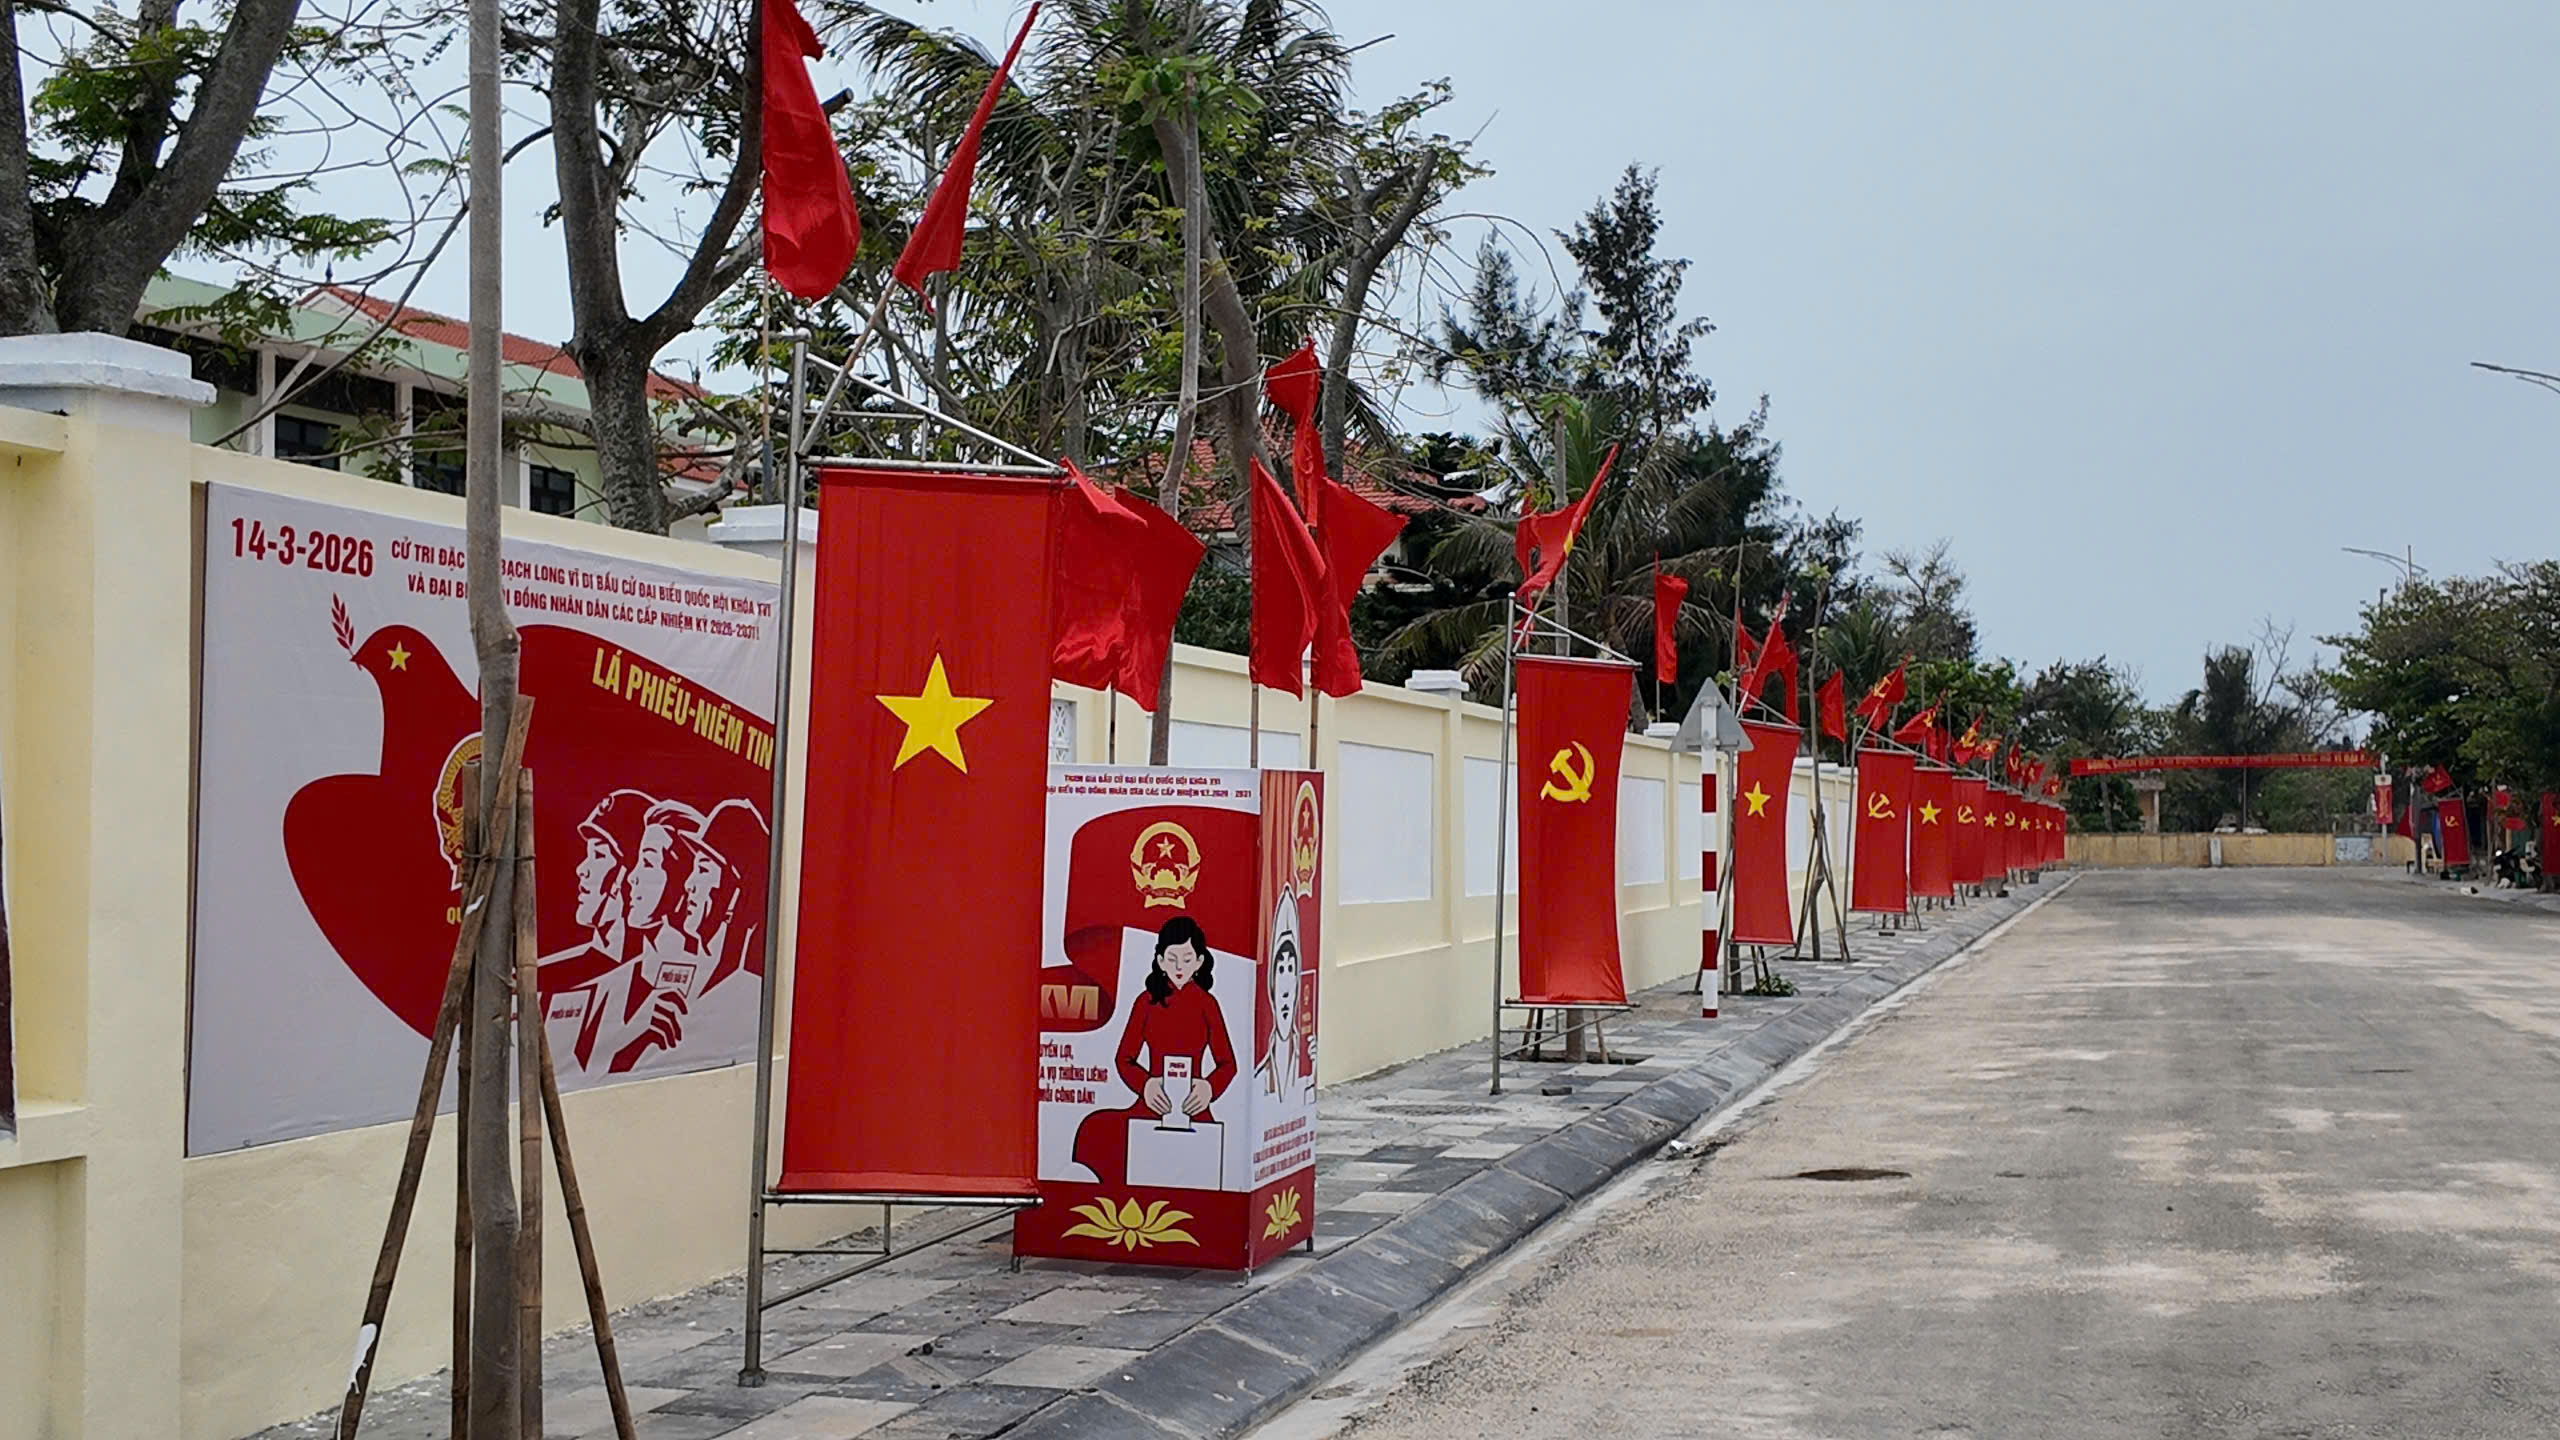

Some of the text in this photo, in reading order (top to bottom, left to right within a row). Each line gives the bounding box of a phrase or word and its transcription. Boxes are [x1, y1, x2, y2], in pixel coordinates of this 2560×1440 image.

[232, 518, 373, 577] 14-3-2026
[392, 536, 411, 560] CỬ
[415, 544, 435, 564] TRI
[438, 546, 465, 571] ĐẶC
[501, 559, 531, 581] BẠCH
[535, 564, 565, 585] LONG
[622, 575, 636, 596] CỬ
[684, 587, 710, 608] QUỐC
[713, 592, 728, 614] HỘI
[408, 571, 425, 594] VÀ
[429, 577, 452, 600] ĐẠI
[550, 594, 583, 616] NHÂN
[586, 598, 609, 619] DÂN
[612, 602, 634, 622] CÁC
[637, 604, 657, 625] CẤP
[661, 611, 693, 633] NHIỆM
[592, 647, 622, 695] LÁ
[745, 725, 774, 771] TIN
